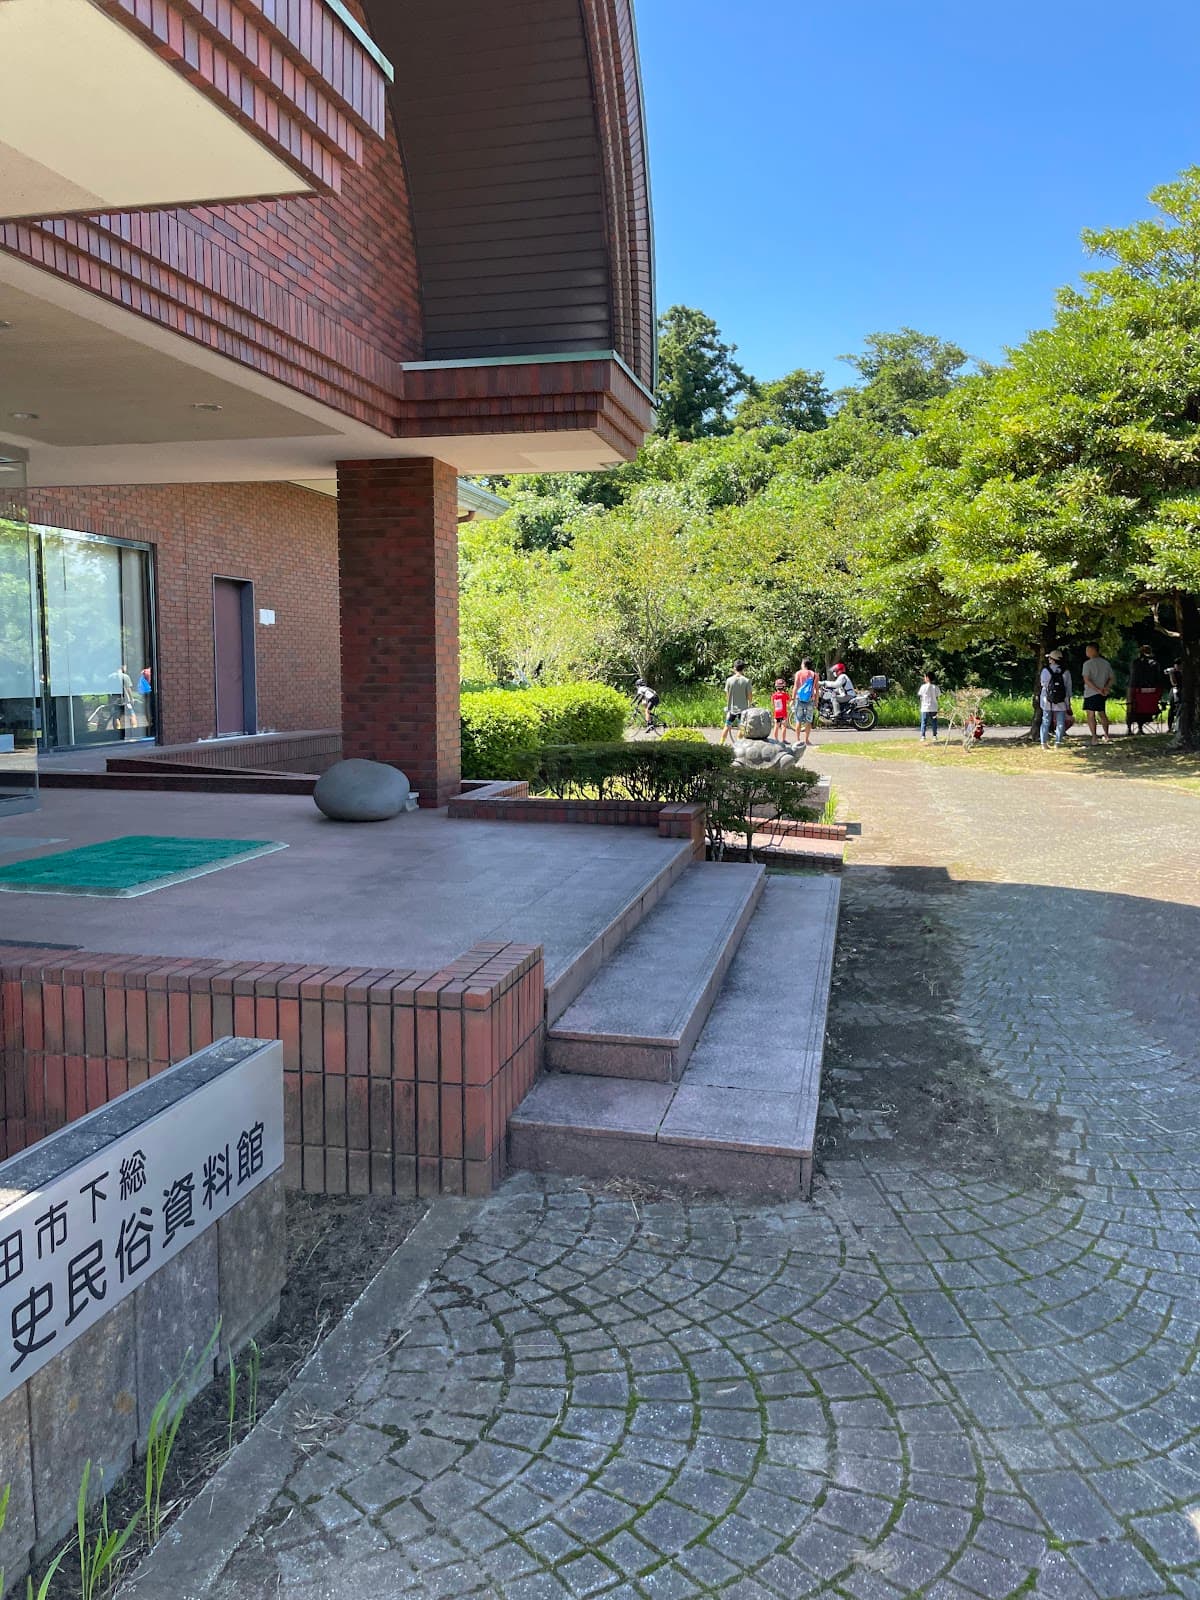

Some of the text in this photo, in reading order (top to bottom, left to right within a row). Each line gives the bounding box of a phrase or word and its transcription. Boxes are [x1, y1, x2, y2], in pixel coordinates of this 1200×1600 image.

[0, 1149, 147, 1289] 田市下総
[10, 1121, 265, 1373] 史民俗資料館
